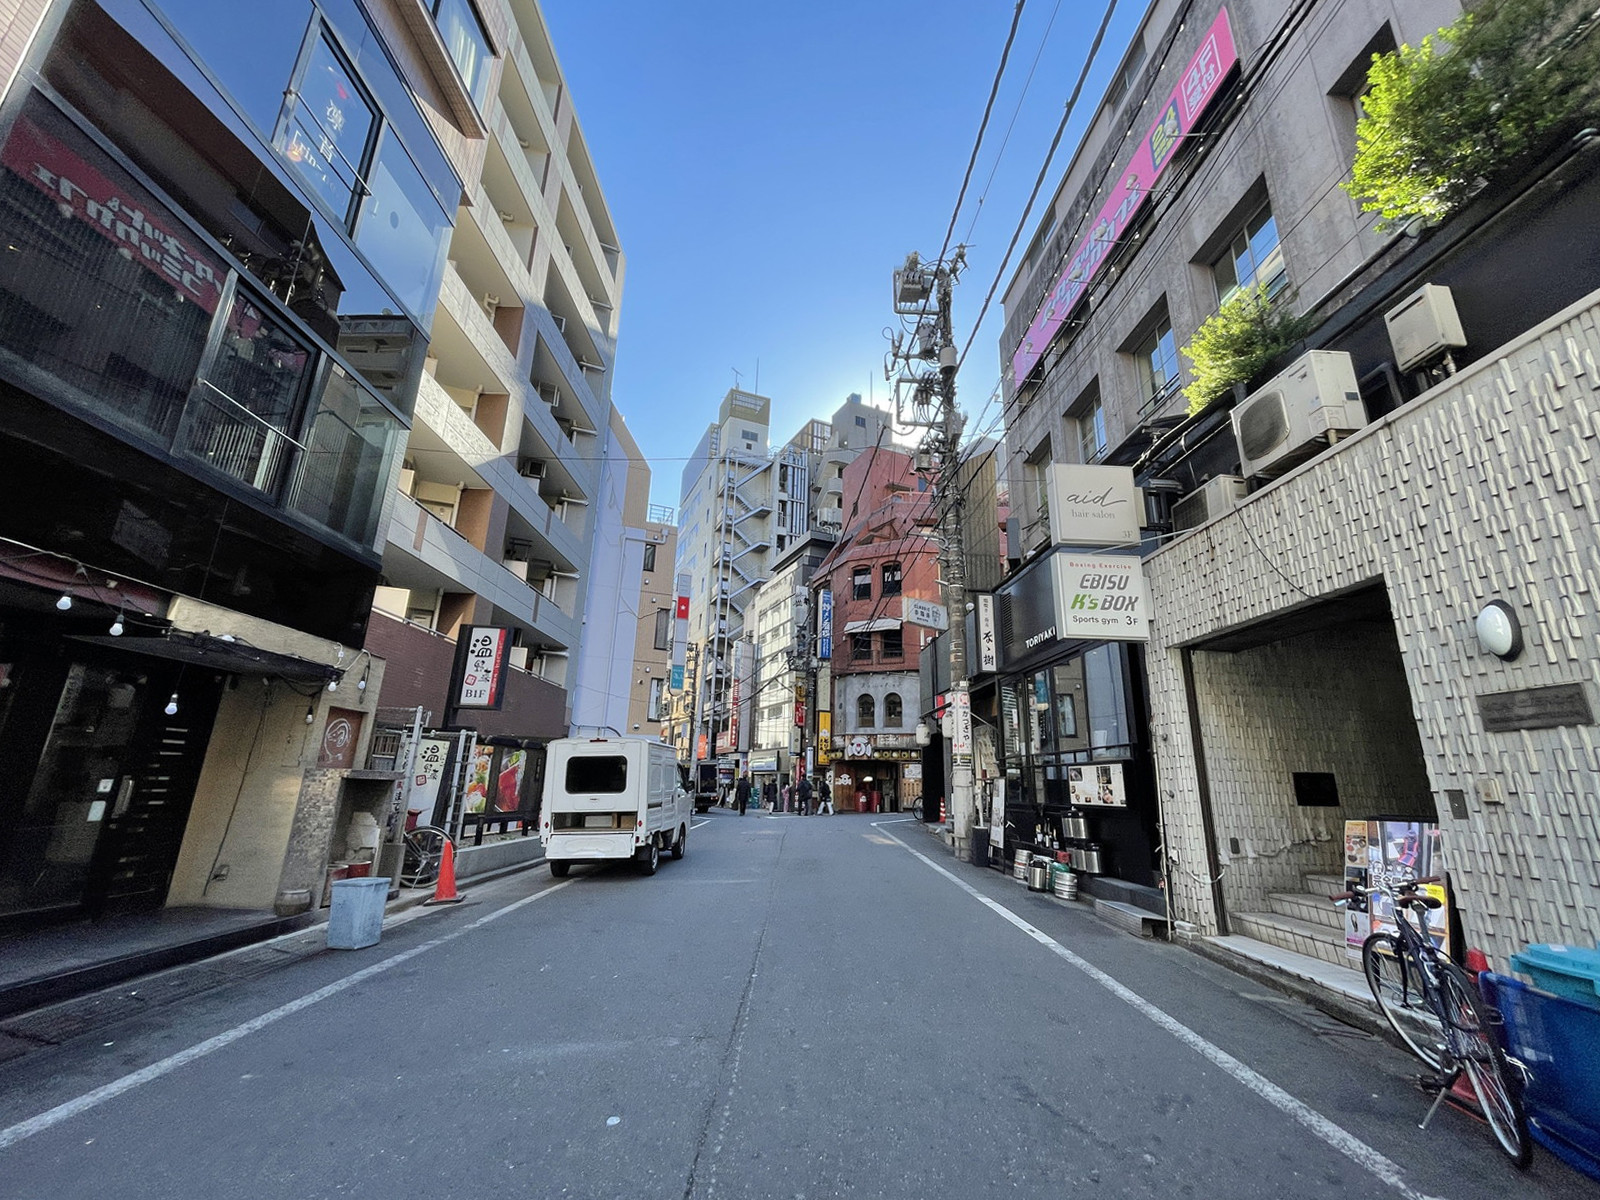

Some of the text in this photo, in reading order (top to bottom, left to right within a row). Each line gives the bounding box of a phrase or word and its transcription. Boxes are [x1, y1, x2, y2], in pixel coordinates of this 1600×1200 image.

[1186, 44, 1213, 96] 4F
[1066, 487, 1127, 507] aid
[1071, 509, 1115, 519] hair salon
[1069, 561, 1096, 569] Boxing
[1080, 573, 1130, 591] EBISU
[1070, 593, 1139, 612] K's BOX
[1072, 614, 1139, 626] Sports gym 3F
[1025, 626, 1056, 649] TORIYAKI
